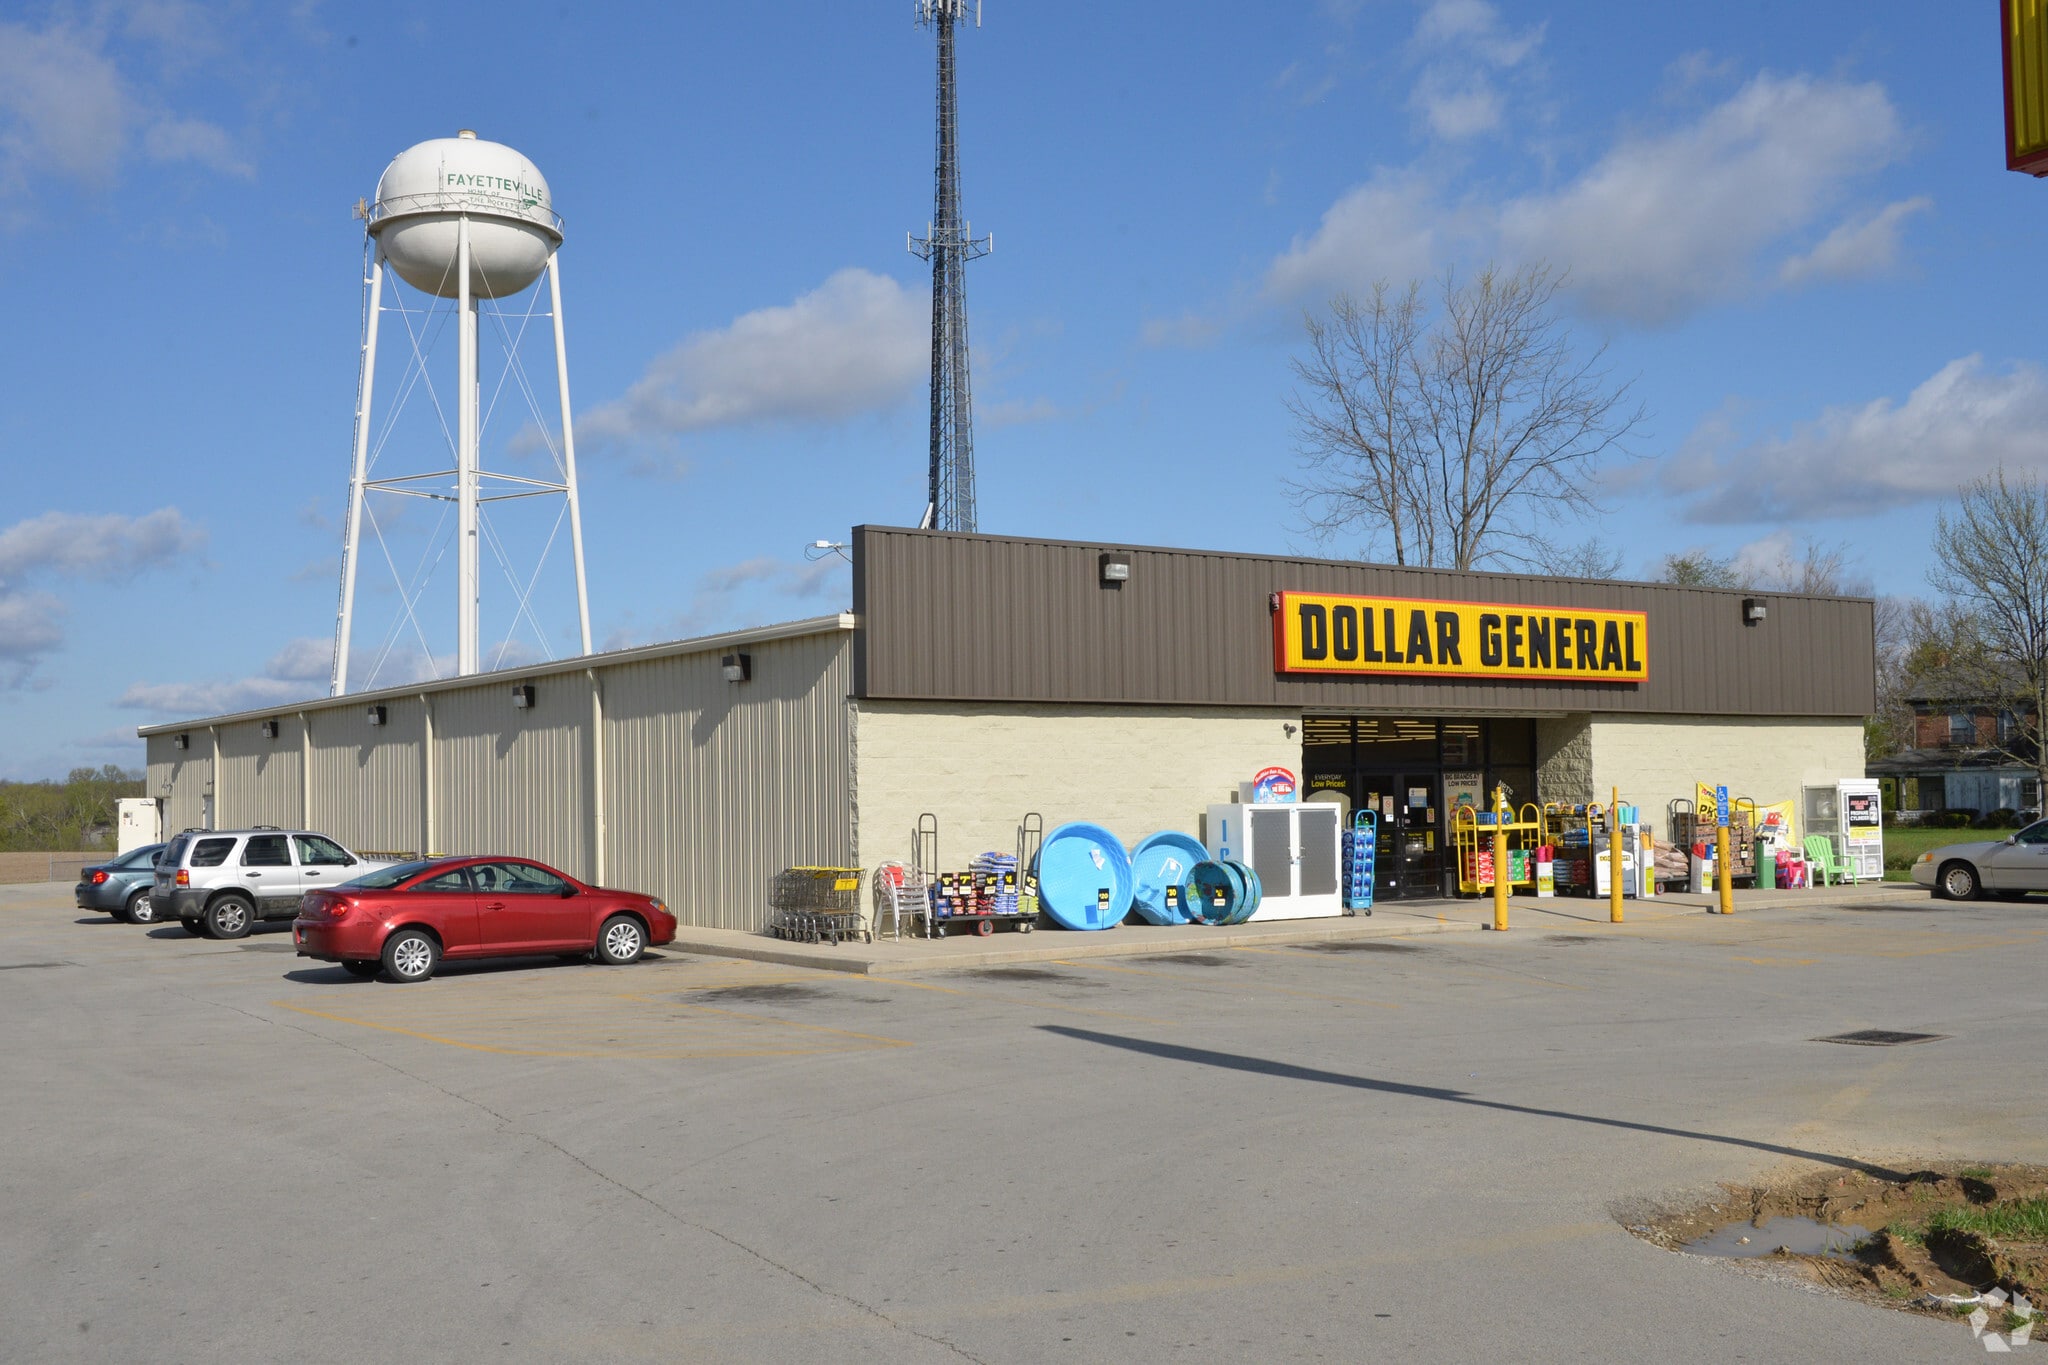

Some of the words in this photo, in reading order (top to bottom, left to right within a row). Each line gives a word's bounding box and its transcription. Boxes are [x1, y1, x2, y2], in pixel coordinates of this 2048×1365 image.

[447, 173, 543, 201] FAYETTEVLLE
[1300, 603, 1462, 666] DOLLAR
[1480, 613, 1641, 671] GENERAL
[1311, 780, 1325, 788] Low
[1325, 779, 1346, 788] Prices!
